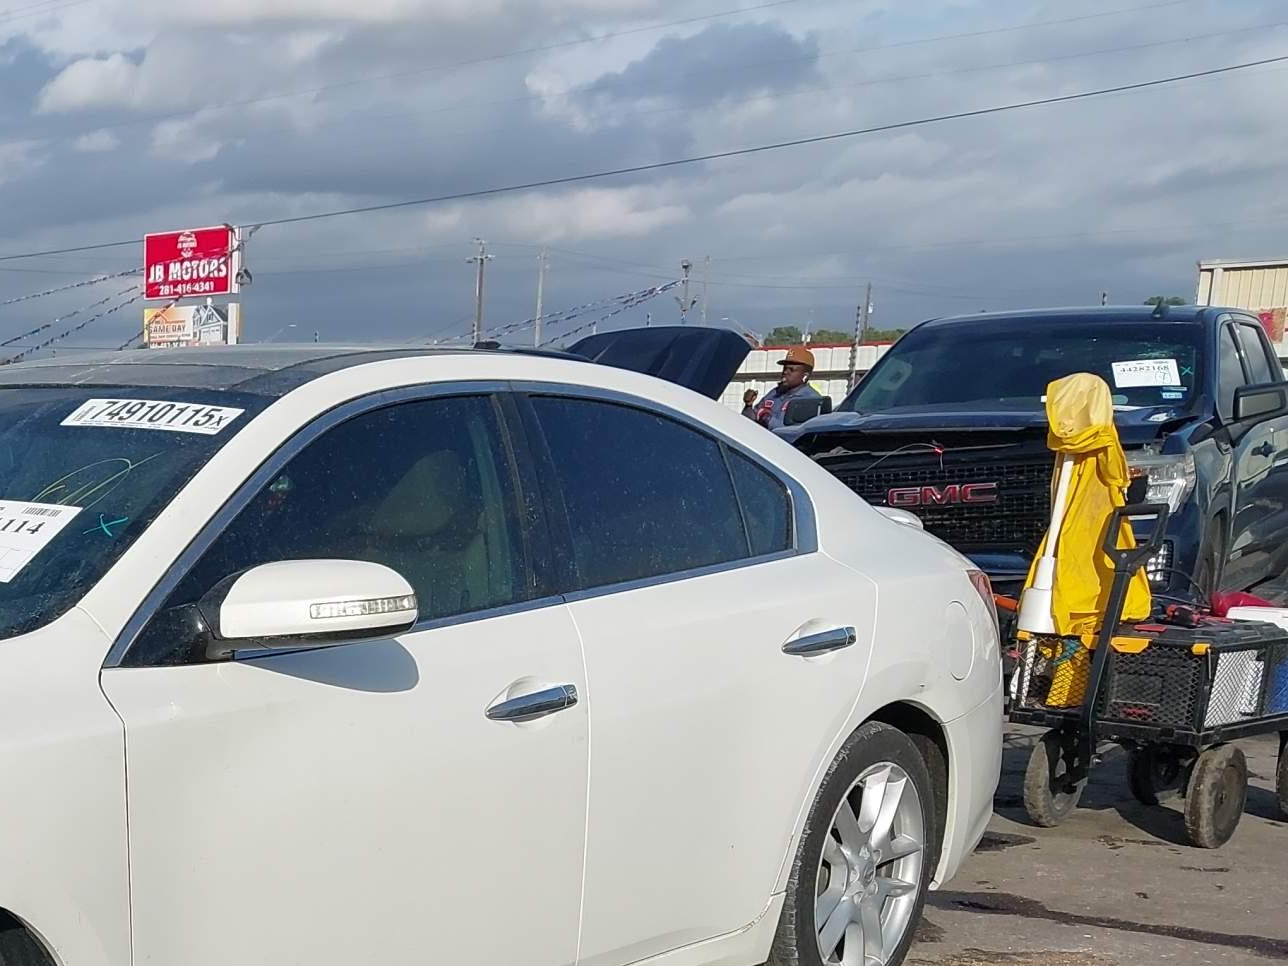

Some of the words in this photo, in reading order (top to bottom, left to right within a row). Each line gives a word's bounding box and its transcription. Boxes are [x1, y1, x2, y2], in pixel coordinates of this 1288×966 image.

[148, 263, 165, 283] JB
[168, 258, 227, 281] MOTORS
[159, 282, 214, 295] 281-416-4341
[887, 482, 999, 507] GMC
